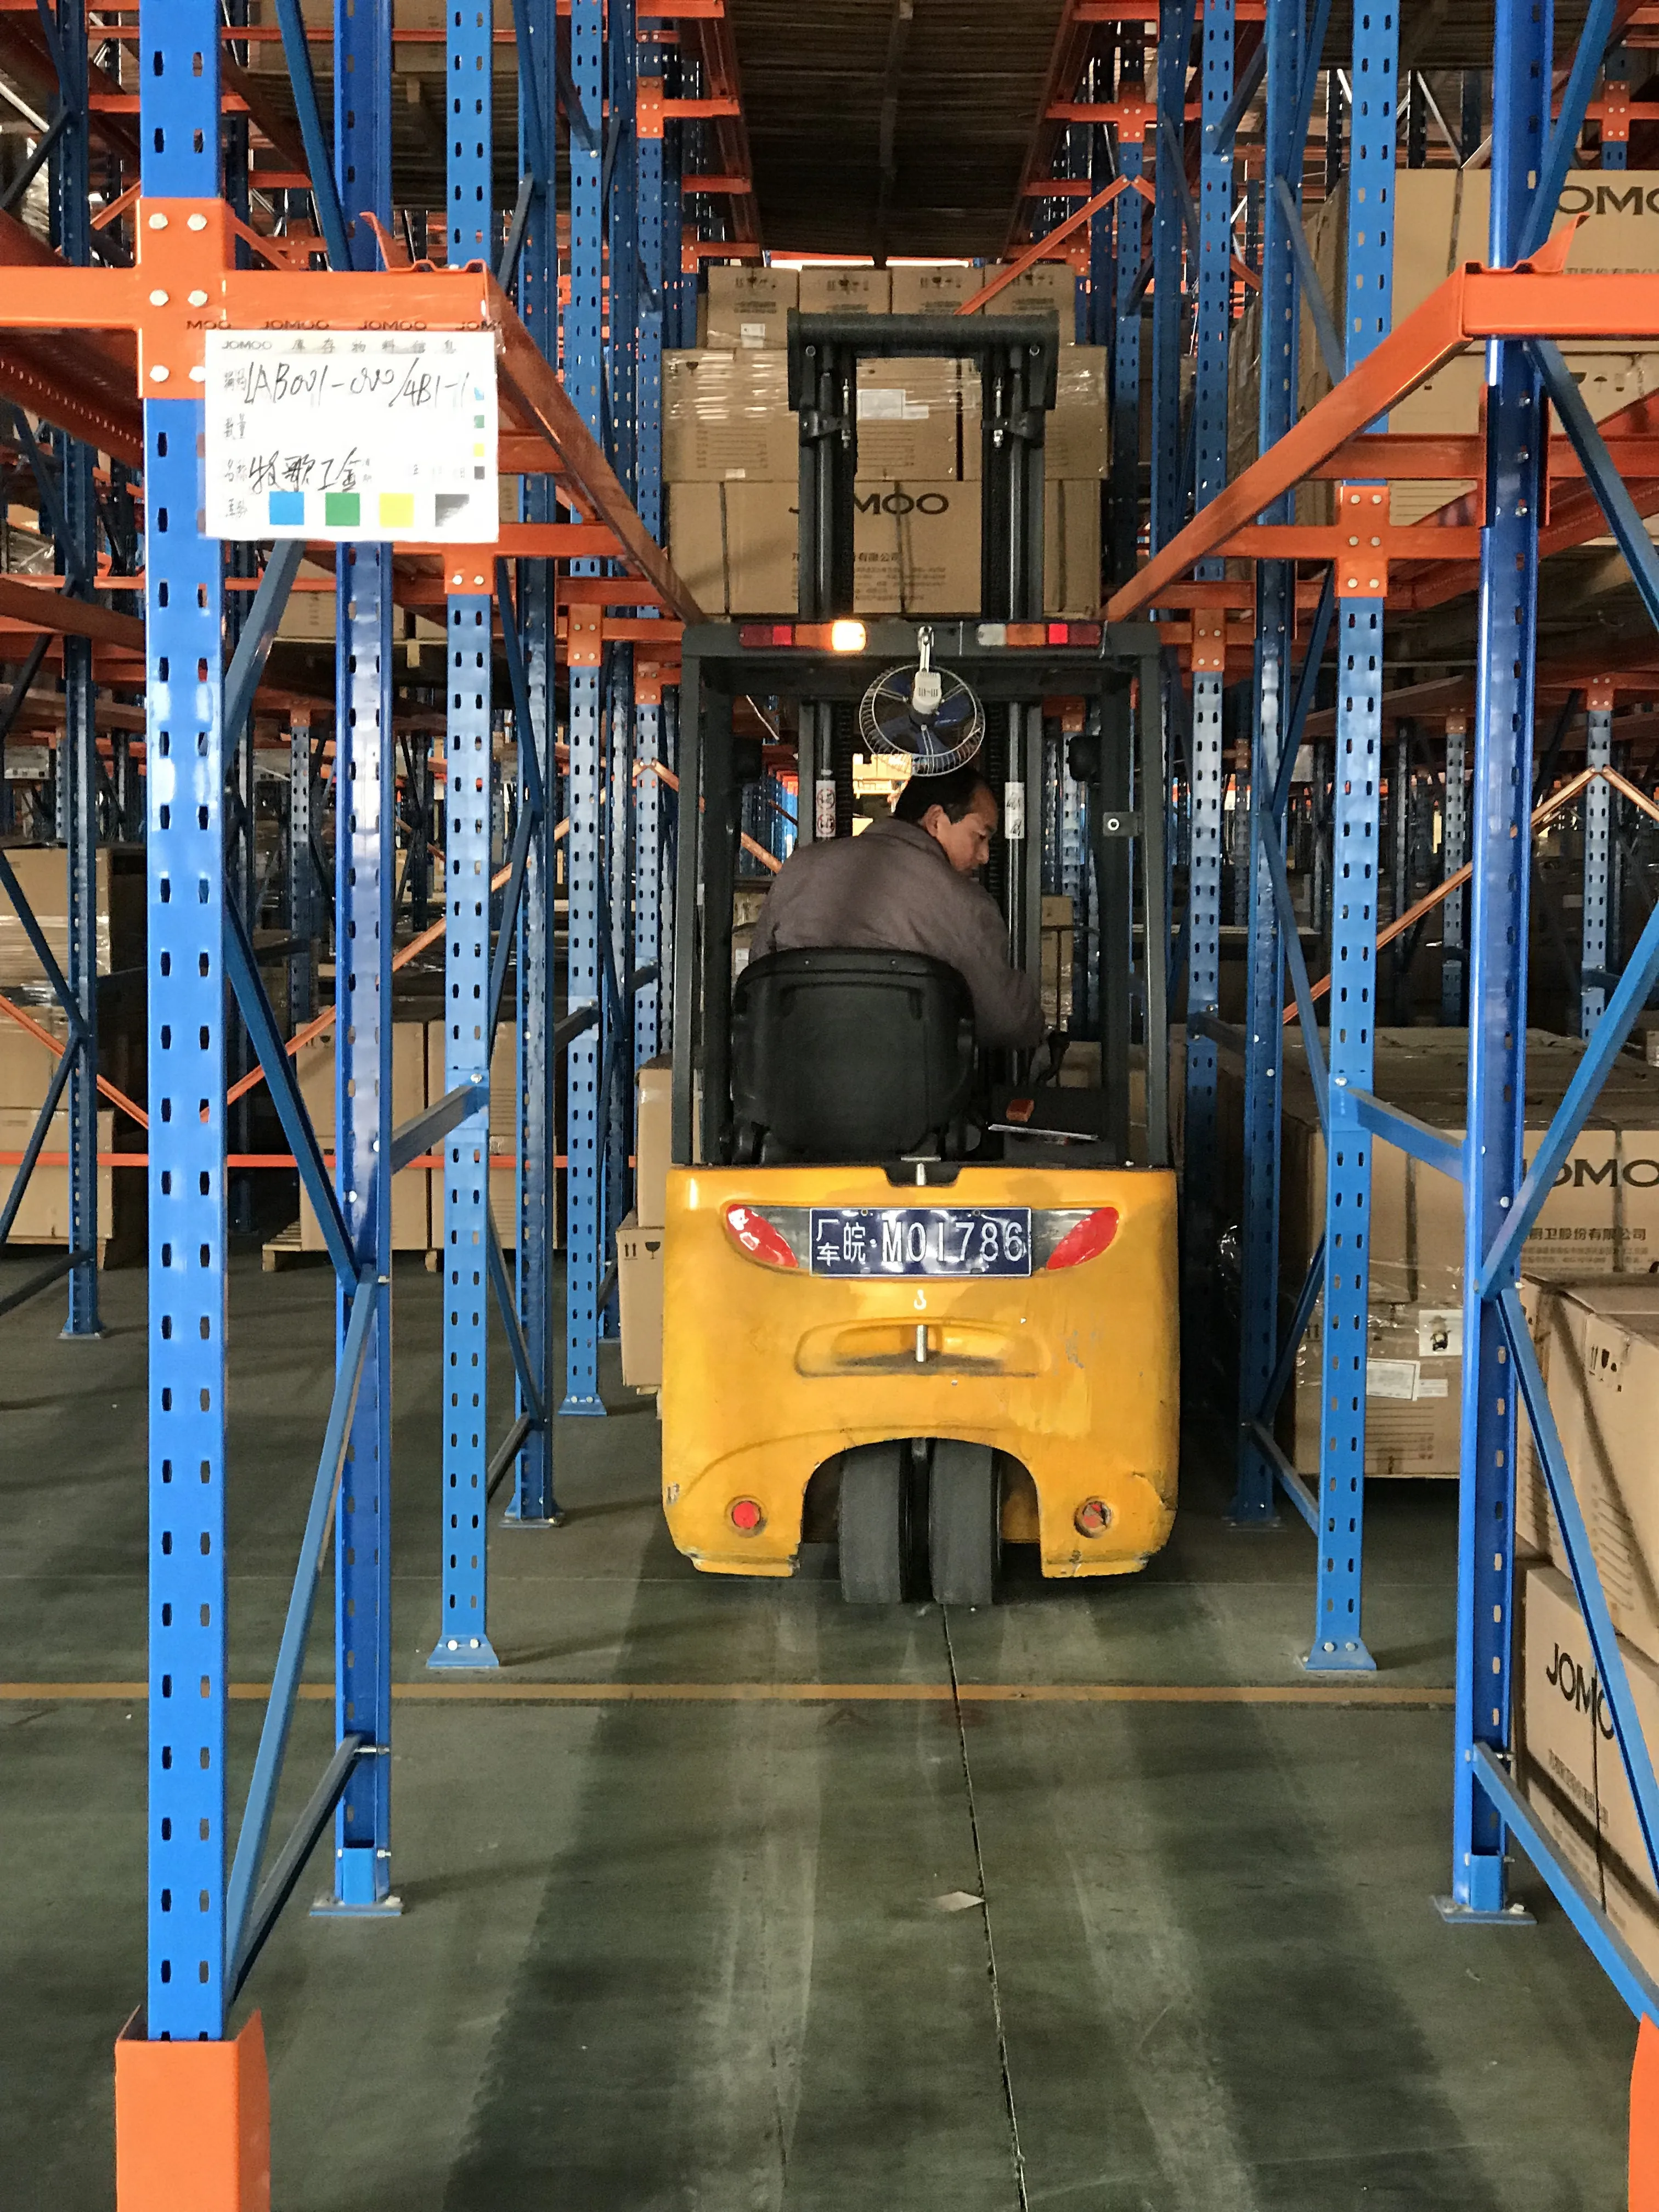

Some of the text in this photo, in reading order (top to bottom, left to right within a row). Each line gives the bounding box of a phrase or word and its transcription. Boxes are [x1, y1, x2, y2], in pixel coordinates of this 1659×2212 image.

[1558, 185, 1659, 215] OM
[259, 320, 329, 330] JOMOO
[358, 320, 426, 330] JOMOO
[222, 340, 273, 350] JOMOO
[788, 493, 949, 515] MOO
[816, 1218, 841, 1267] 厂车
[1527, 1228, 1646, 1240] 厨卫股份有限公司
[1546, 1642, 1615, 1740] JOMO
